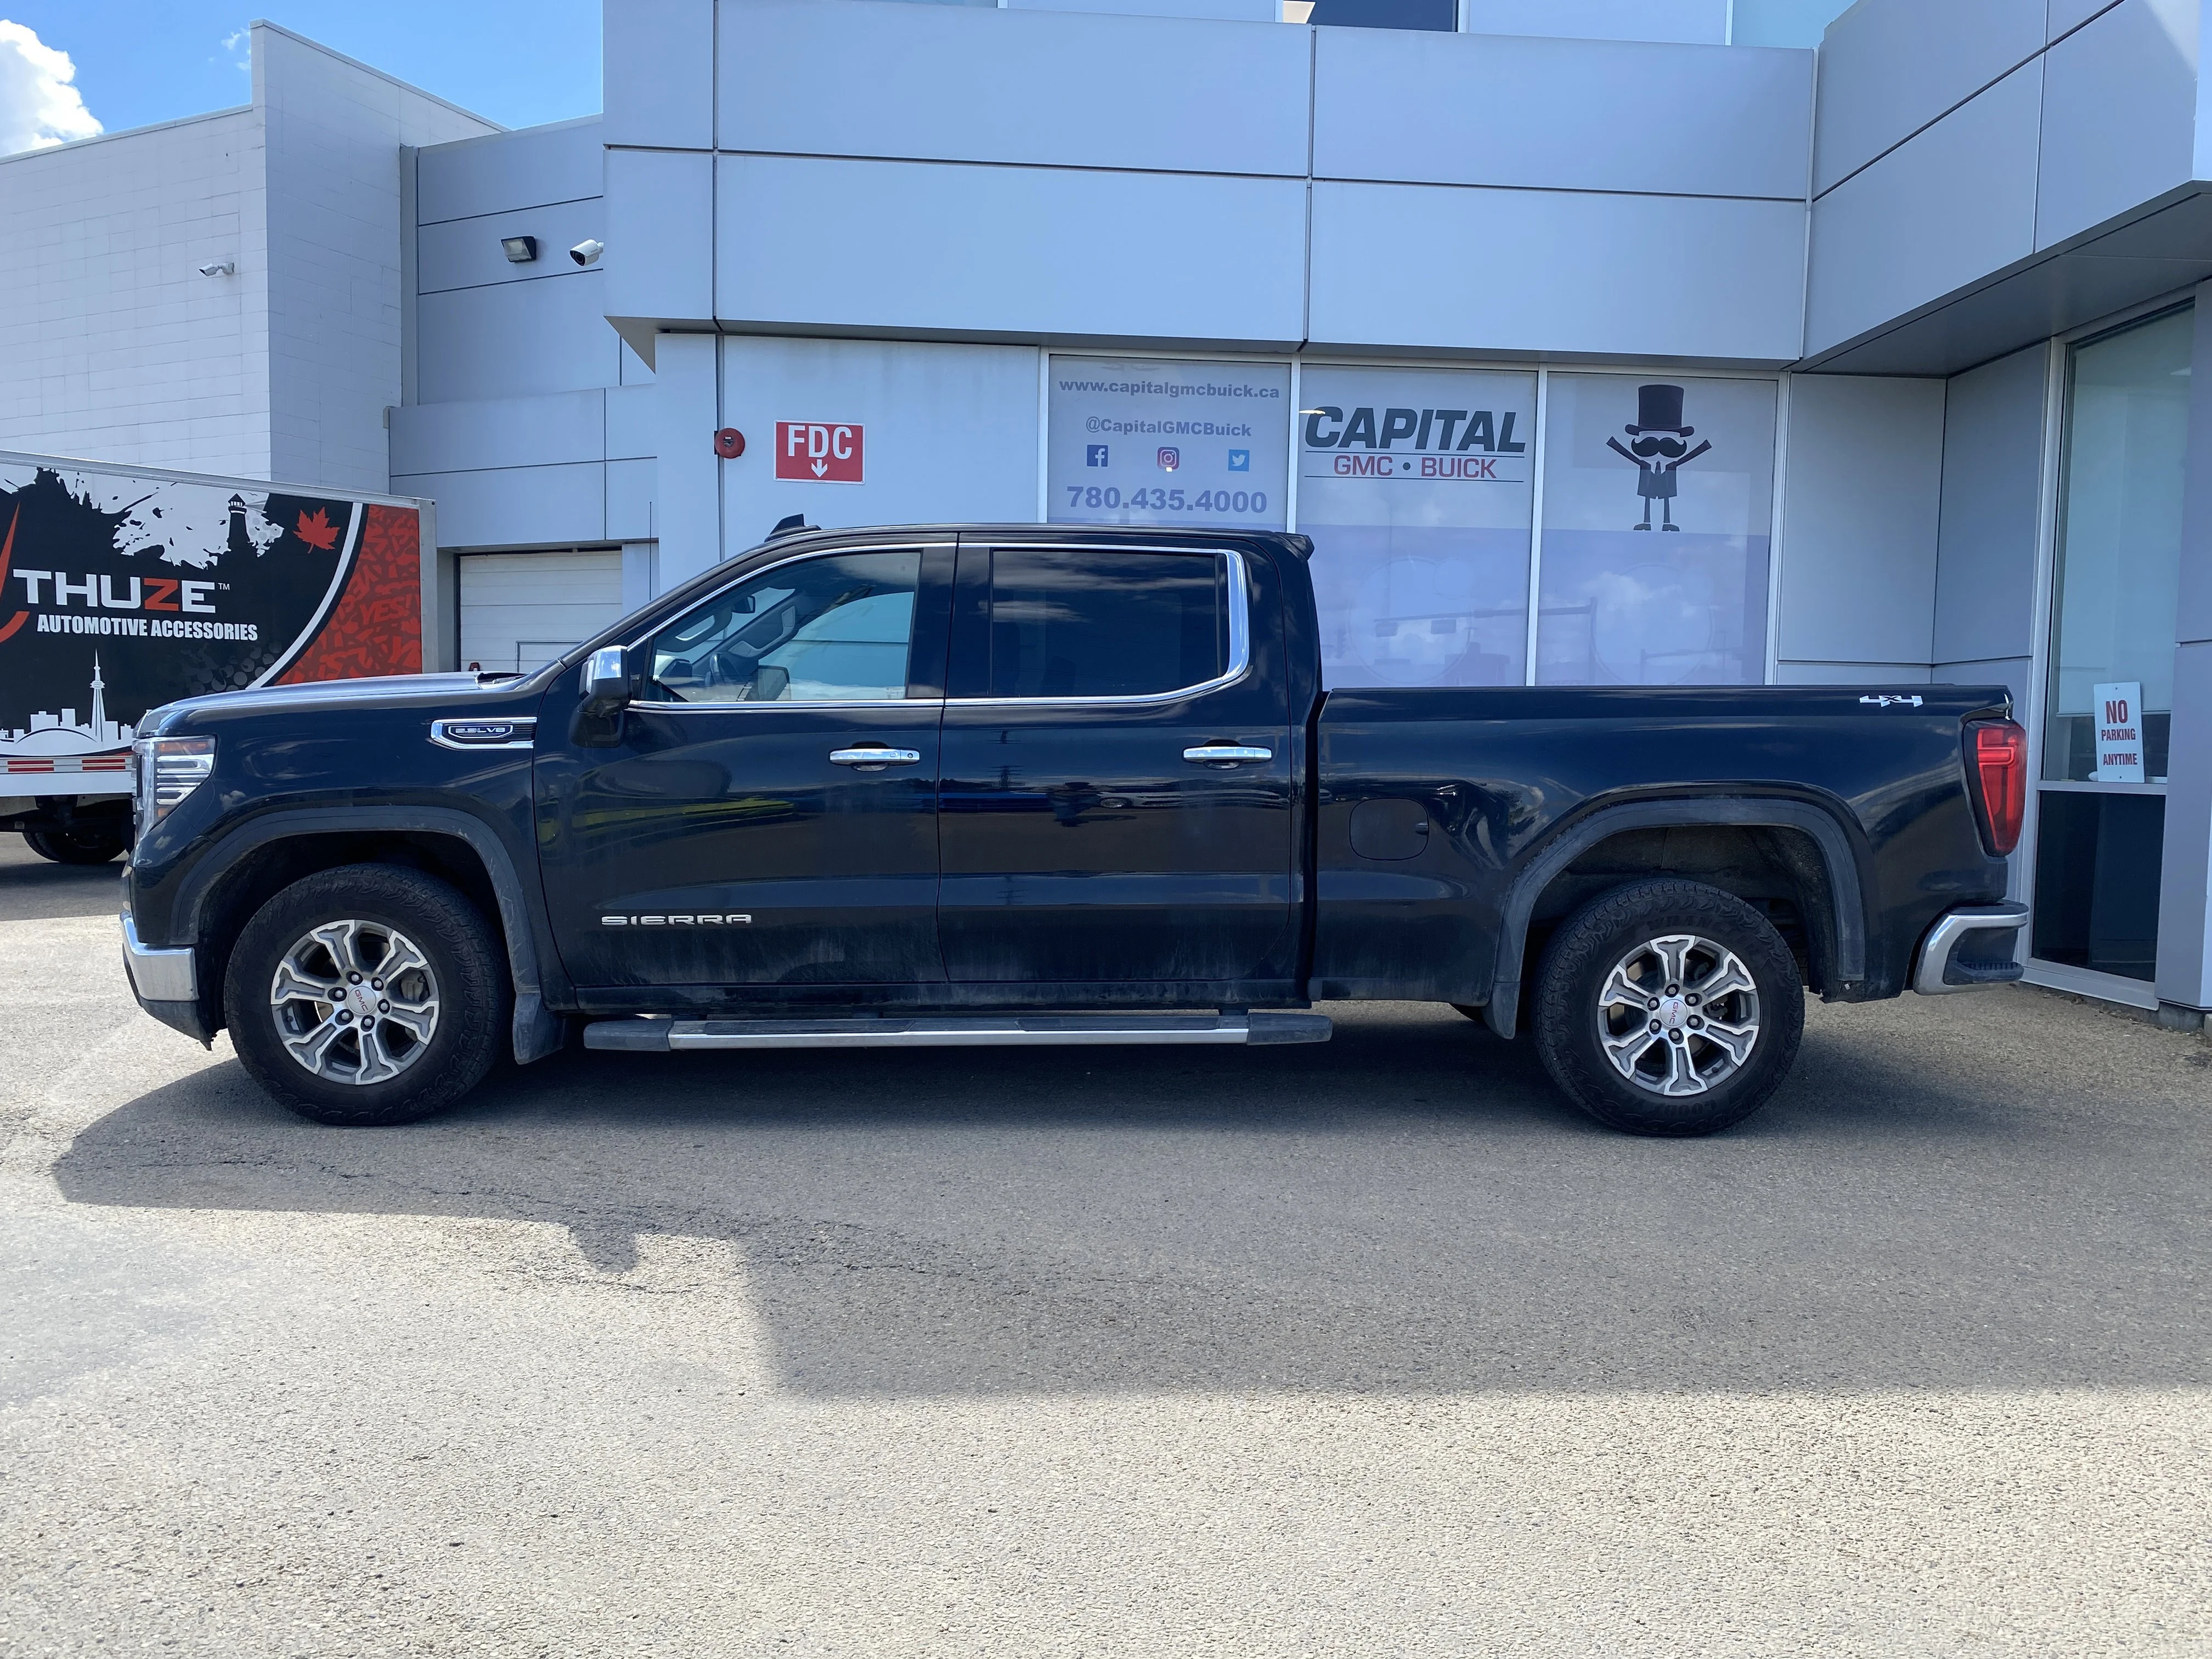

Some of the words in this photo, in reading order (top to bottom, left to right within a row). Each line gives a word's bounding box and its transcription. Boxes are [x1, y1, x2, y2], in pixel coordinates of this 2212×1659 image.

[1059, 381, 1279, 398] www.capitalgmcbuick.ca
[1086, 416, 1251, 436] @CapitalGMCBuick
[1305, 406, 1526, 453] CAPITAL
[788, 425, 852, 459] FDC
[1334, 455, 1393, 476] GMC
[1421, 457, 1497, 478] BUICK
[1066, 486, 1267, 513] 780.435.4000
[13, 568, 216, 613] THUZE
[37, 614, 148, 636] AUTOMOTIVE
[151, 619, 258, 641] ACCESSORIES
[2106, 699, 2128, 724] NO
[2101, 728, 2136, 741] PARKING
[2103, 753, 2137, 765] ANYTIME
[601, 914, 752, 926] SIERRA
[355, 989, 369, 1012] GMC
[1669, 1002, 1678, 1024] GMC
